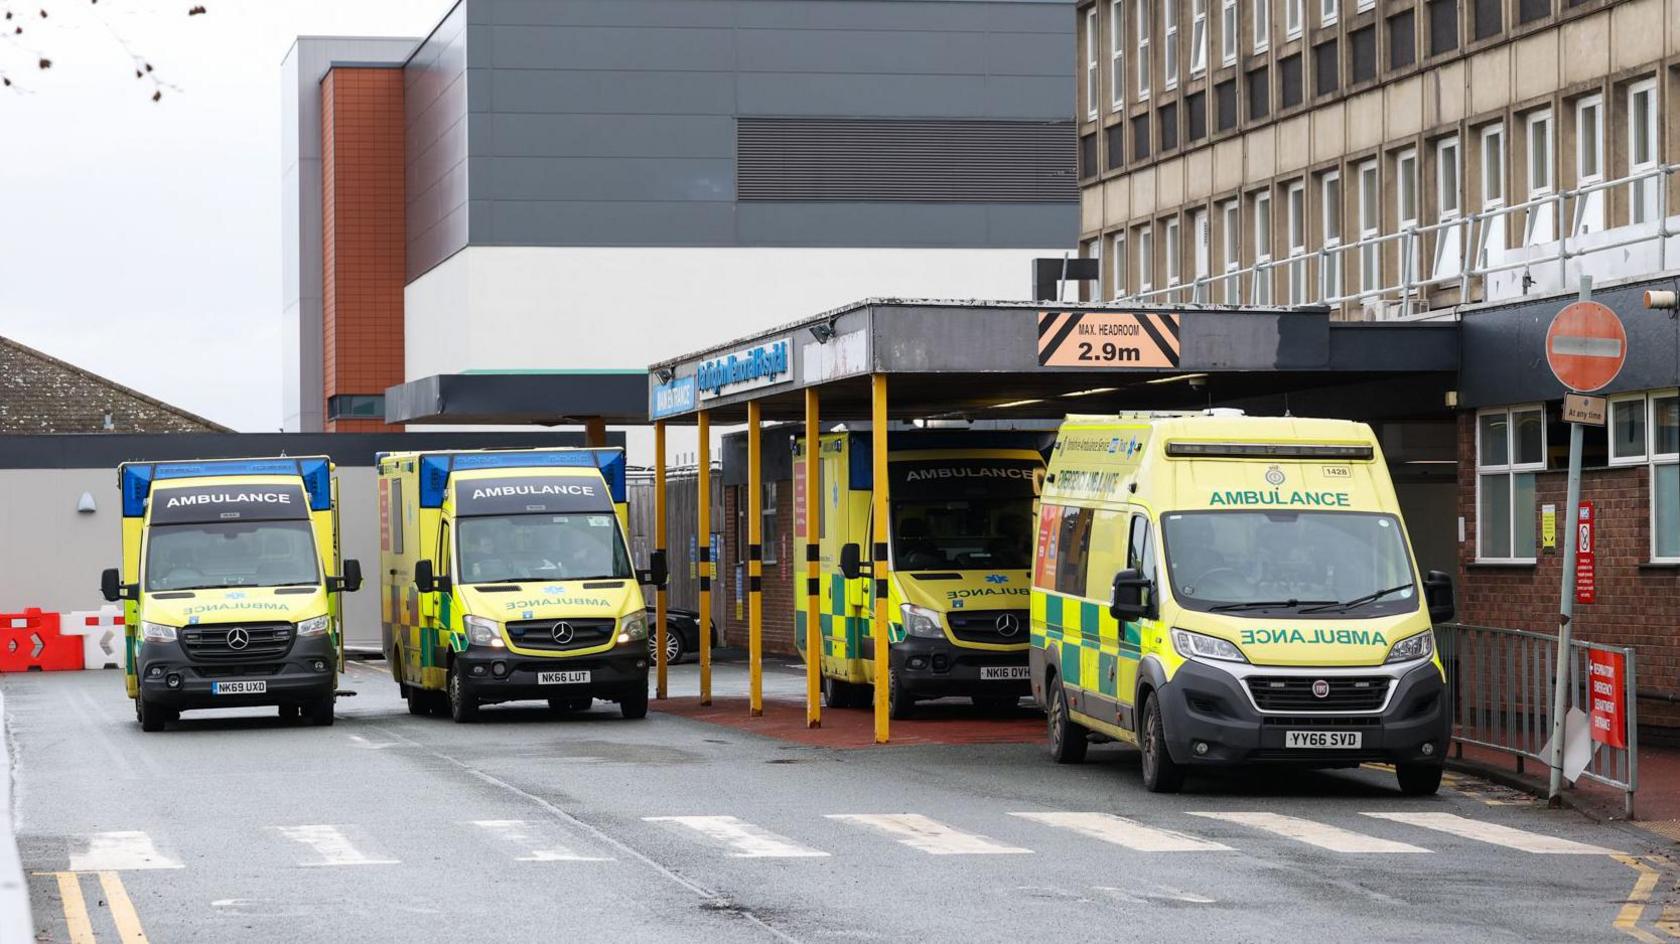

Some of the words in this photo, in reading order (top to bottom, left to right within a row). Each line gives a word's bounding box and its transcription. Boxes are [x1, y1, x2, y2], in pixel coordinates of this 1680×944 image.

[1078, 324, 1096, 336] MAX.
[1099, 324, 1140, 336] HEADROOM
[1078, 342, 1140, 361] 2.9m
[668, 384, 690, 409] ENTRANCE
[1569, 408, 1576, 416] At
[1577, 411, 1587, 420] any
[1589, 410, 1602, 419] time
[907, 468, 1033, 481] AMBULANCE
[1327, 468, 1347, 476] 1428
[472, 485, 595, 499] AMBULANCE
[1209, 490, 1350, 507] AMBULANCE
[167, 492, 291, 507] AMBULANCE
[542, 673, 567, 682] NK66
[568, 672, 587, 682] LUT
[986, 667, 1009, 678] NK16
[1011, 667, 1031, 677] OVH
[219, 682, 244, 693] NK69
[246, 681, 265, 692] UXD
[1292, 733, 1327, 746] YY66
[1330, 733, 1356, 746] SVD
